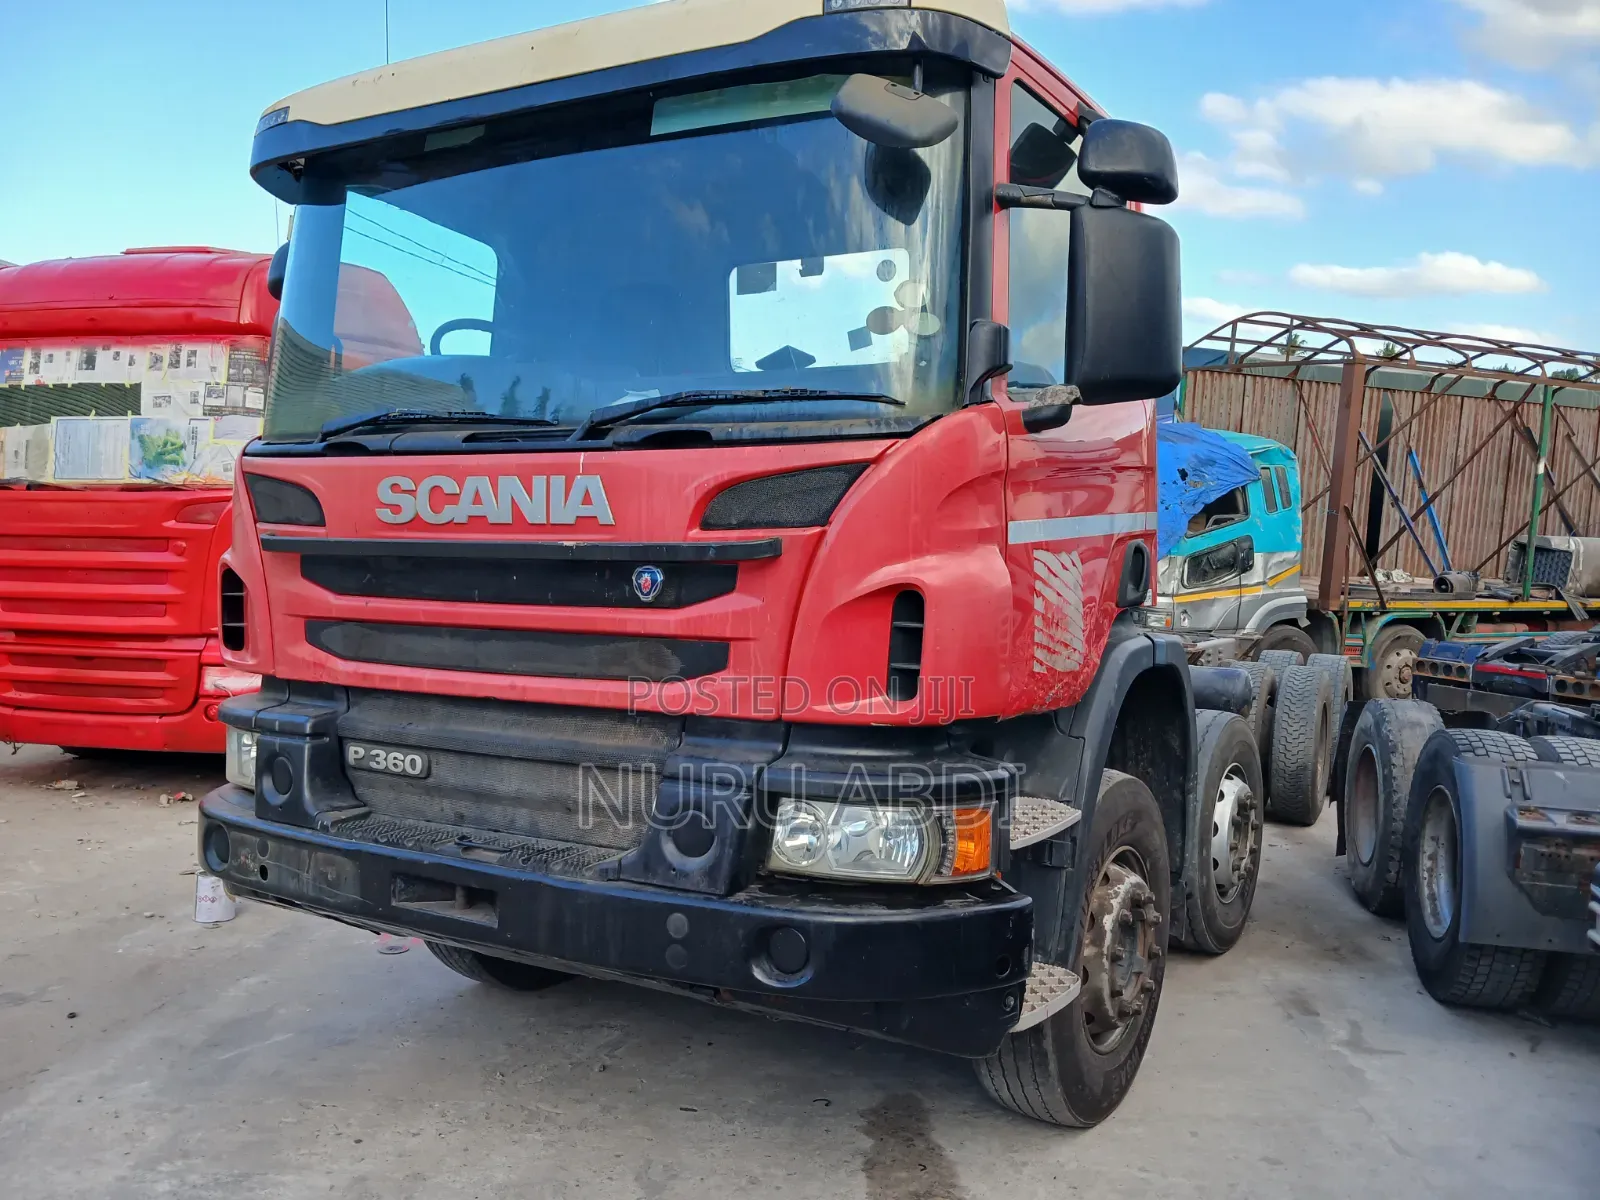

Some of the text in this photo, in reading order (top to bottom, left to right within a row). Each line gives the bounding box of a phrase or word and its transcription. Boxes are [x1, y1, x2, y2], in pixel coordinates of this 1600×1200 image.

[375, 475, 616, 526] SCANIA
[348, 745, 423, 775] P 360
